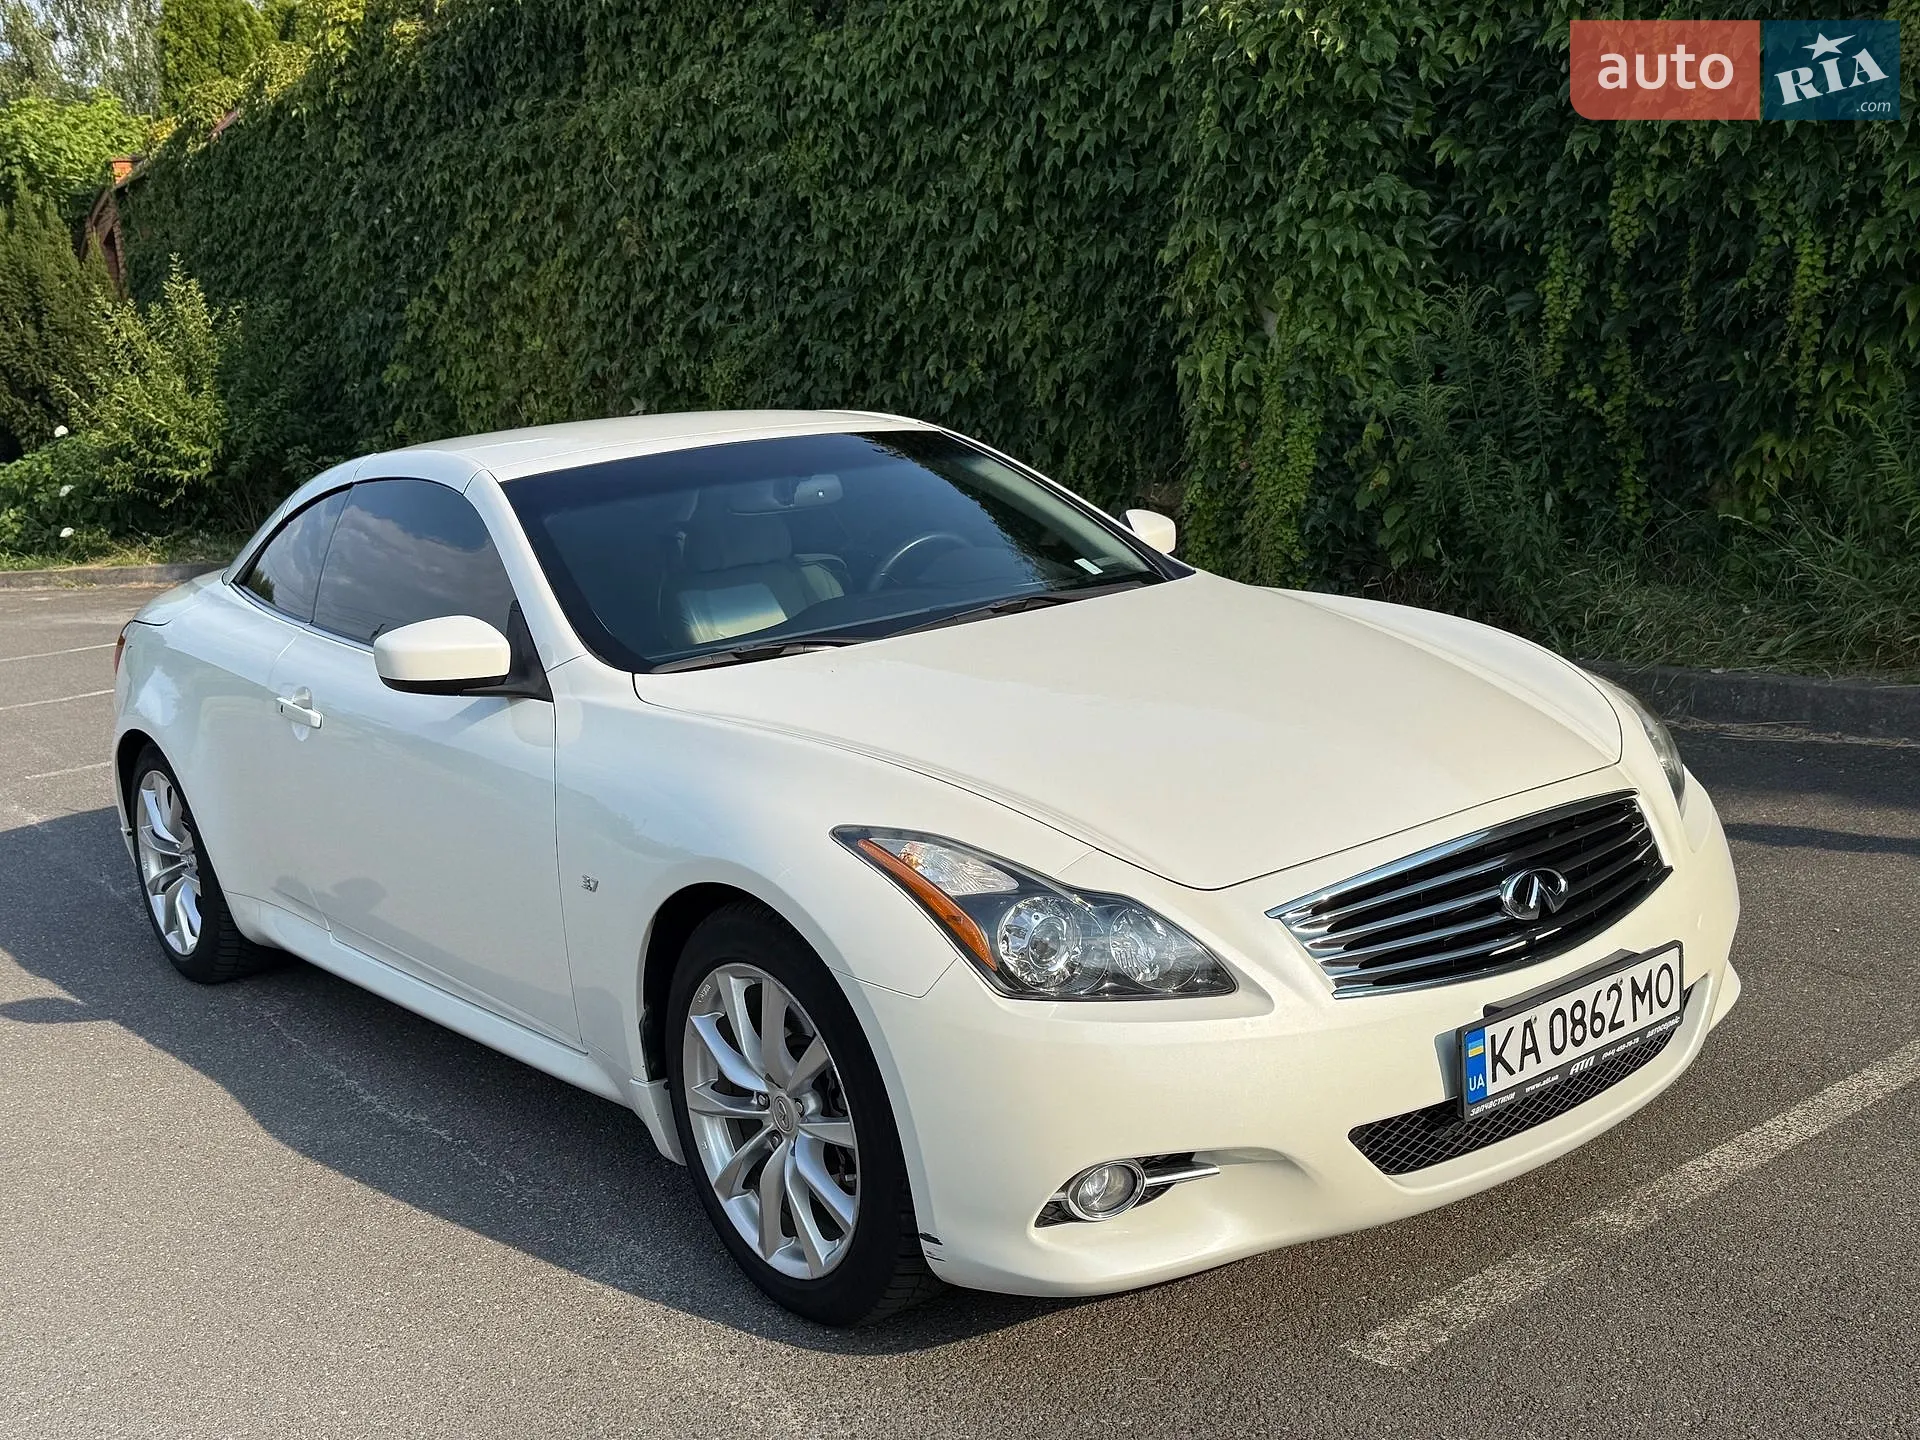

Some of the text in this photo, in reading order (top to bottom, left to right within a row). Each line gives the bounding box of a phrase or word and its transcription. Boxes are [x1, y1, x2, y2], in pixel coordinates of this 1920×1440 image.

[1490, 962, 1674, 1083] KA 0862 MO
[1469, 1074, 1485, 1092] UA
